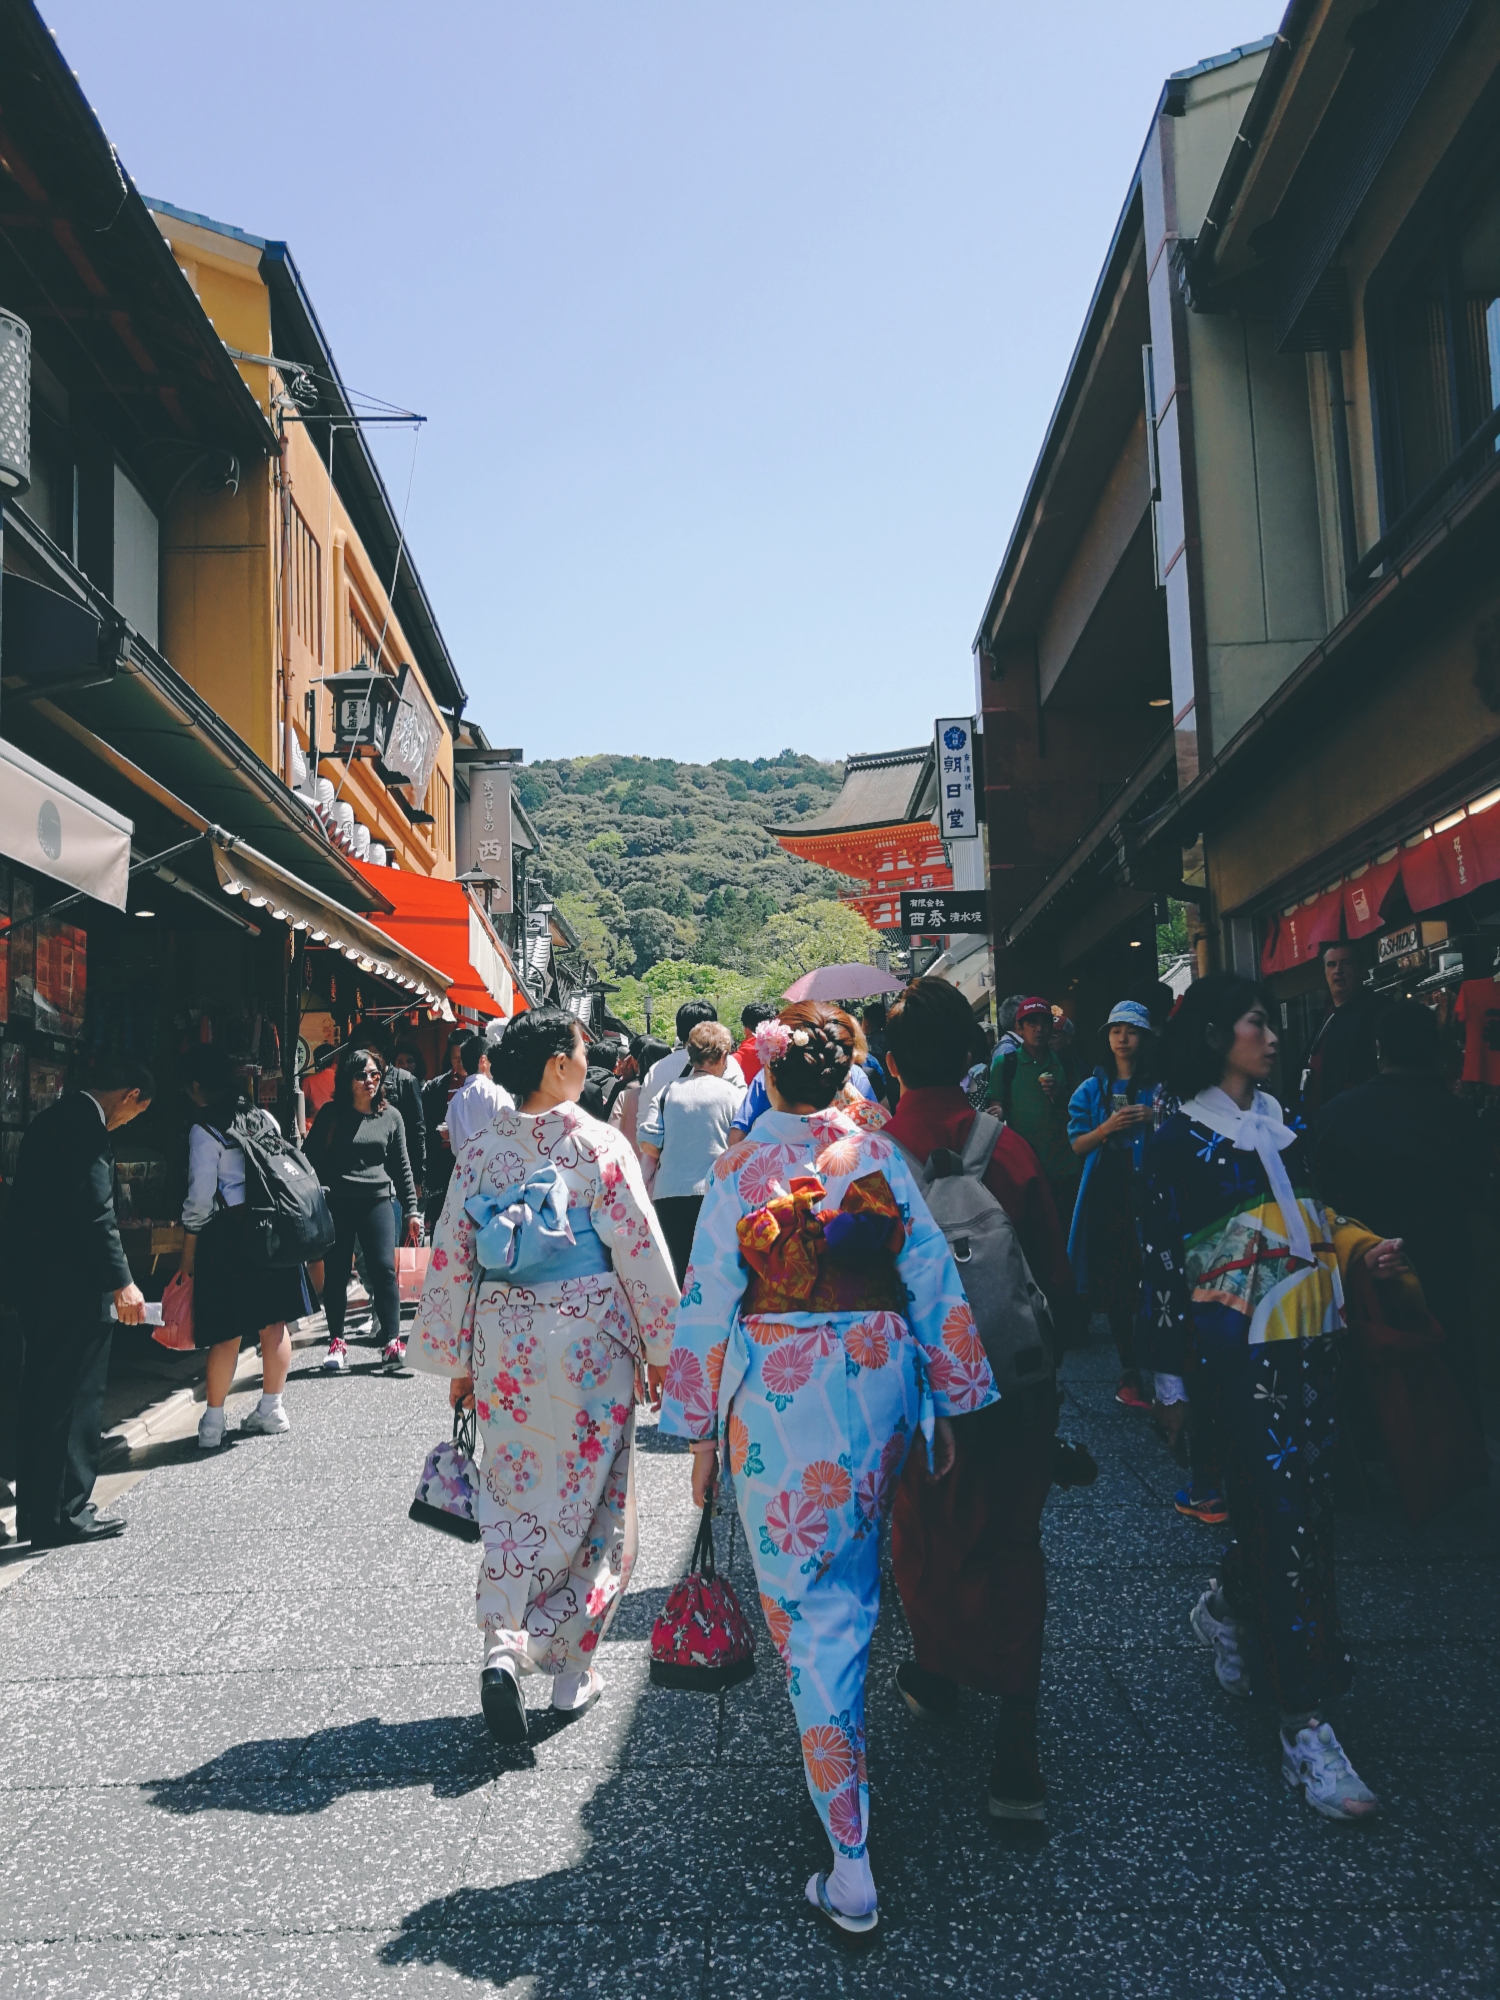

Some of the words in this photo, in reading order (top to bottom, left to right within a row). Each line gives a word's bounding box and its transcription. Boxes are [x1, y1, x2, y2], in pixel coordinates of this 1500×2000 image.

[483, 779, 494, 832] 京つけもの
[944, 755, 964, 829] 朝日堂
[909, 898, 945, 908] 有限会社
[909, 909, 947, 927] 西秀
